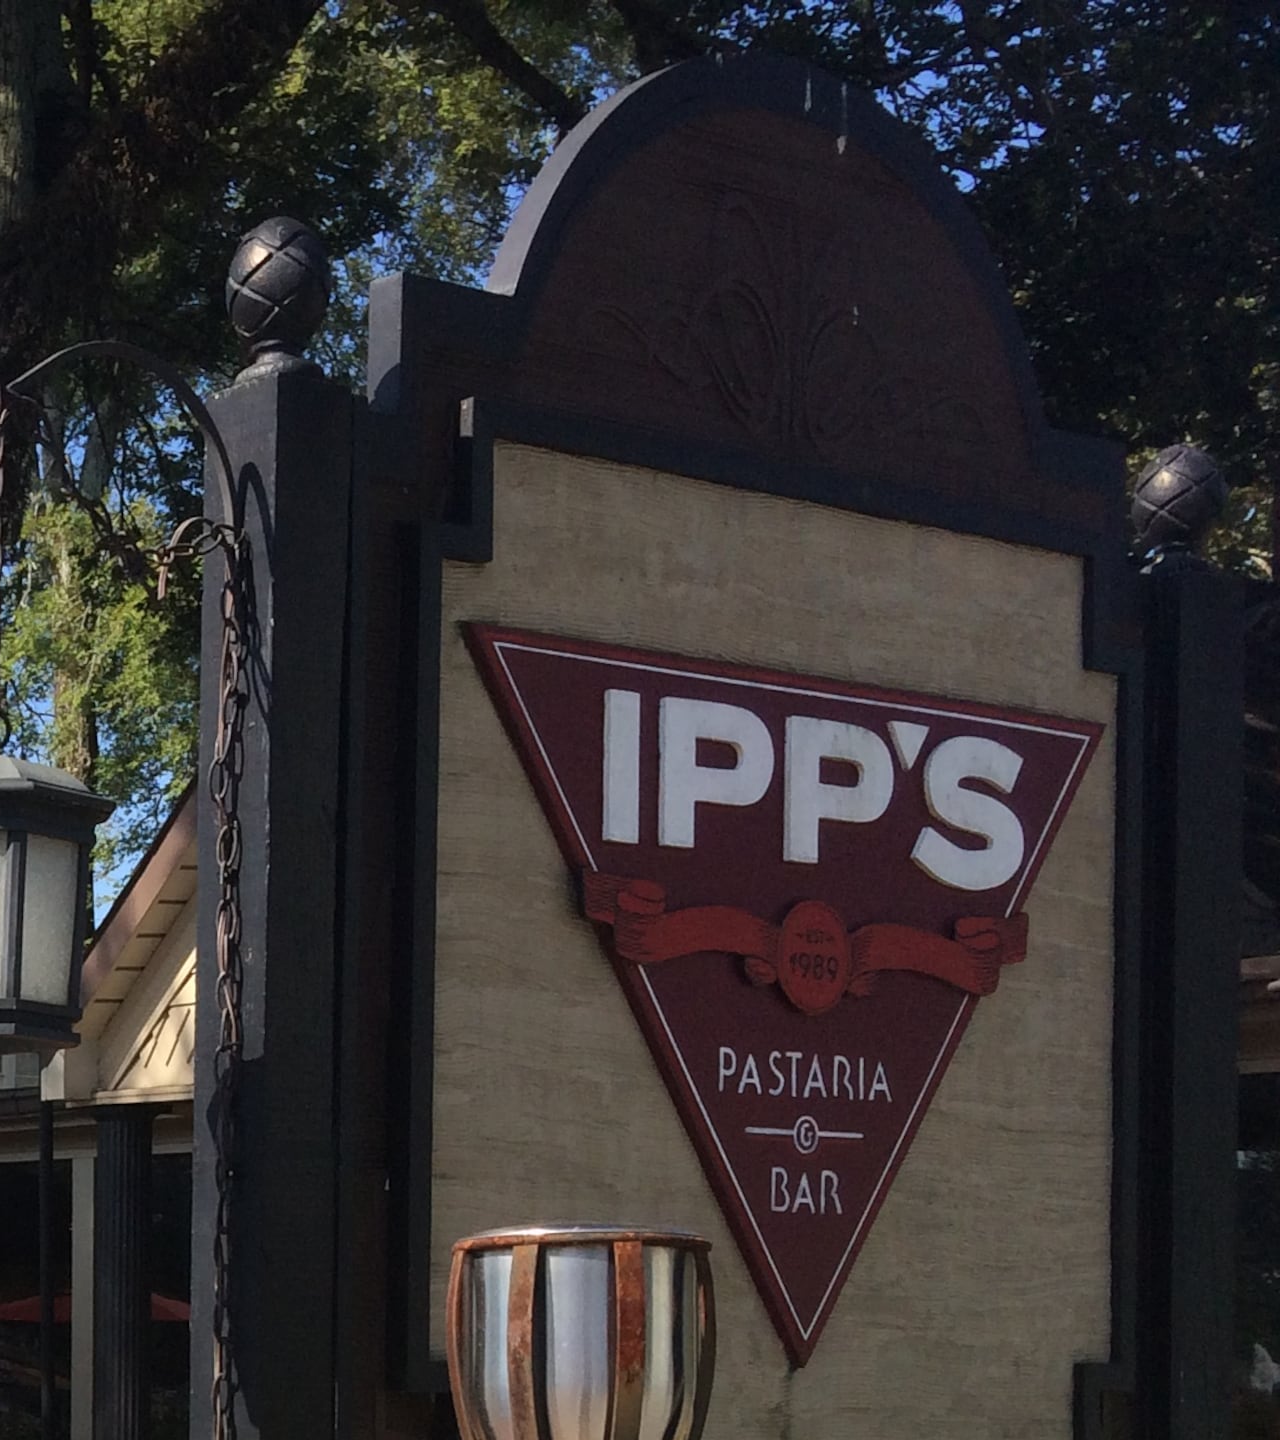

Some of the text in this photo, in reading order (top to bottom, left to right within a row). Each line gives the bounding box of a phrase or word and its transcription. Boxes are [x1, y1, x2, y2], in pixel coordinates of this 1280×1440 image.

[601, 688, 1026, 892] IPP'S
[789, 952, 839, 984] 1989
[717, 1045, 893, 1103] PASTARIA
[770, 1165, 843, 1215] BAR
